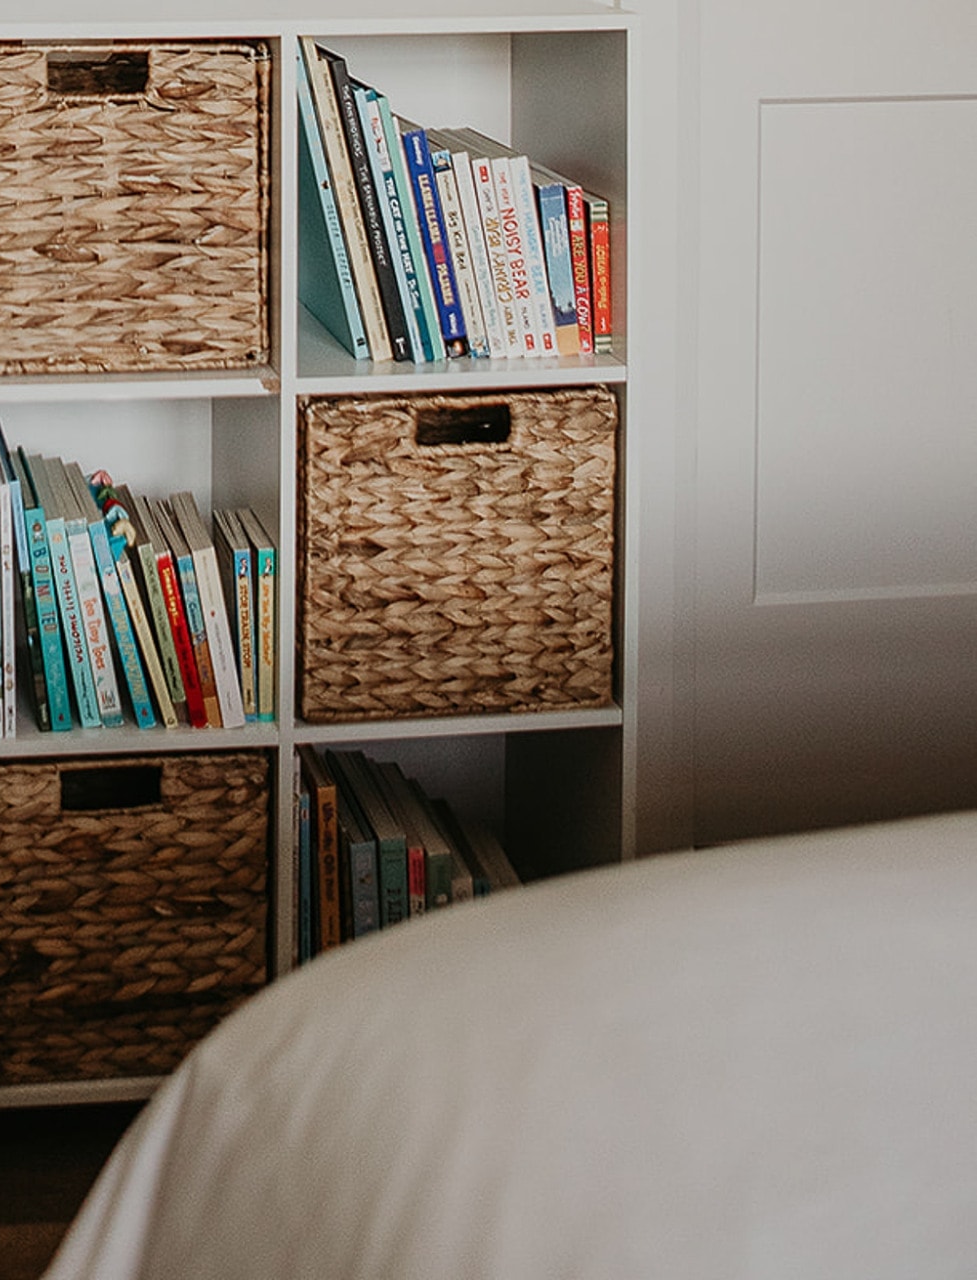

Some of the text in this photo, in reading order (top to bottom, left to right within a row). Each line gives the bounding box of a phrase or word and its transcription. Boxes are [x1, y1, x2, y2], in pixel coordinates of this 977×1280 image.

[384, 176, 396, 198] THE
[417, 173, 434, 209] LLAMA
[358, 164, 369, 182] THE
[371, 229, 387, 267] PROJECT
[388, 198, 401, 219] CAT
[446, 210, 458, 228] Big
[396, 232, 408, 251] THE
[424, 208, 441, 244] LLAMA
[451, 230, 463, 248] Kid
[484, 215, 503, 248] BEAR
[499, 206, 522, 256] NOISY
[400, 252, 413, 274] HAT
[455, 250, 467, 270] Bed
[521, 211, 539, 260] HUNGRY
[530, 264, 545, 295] BEAR
[435, 262, 454, 306] PAJAMA
[490, 250, 513, 304] CRANKY
[508, 257, 530, 300] BEAR
[572, 233, 590, 332] ARE YOU A COW?
[446, 312, 458, 335] Viking
[57, 554, 68, 575] one
[61, 579, 75, 611] little
[67, 613, 85, 664] welcome
[82, 597, 109, 670] Ten Tiny Toes
